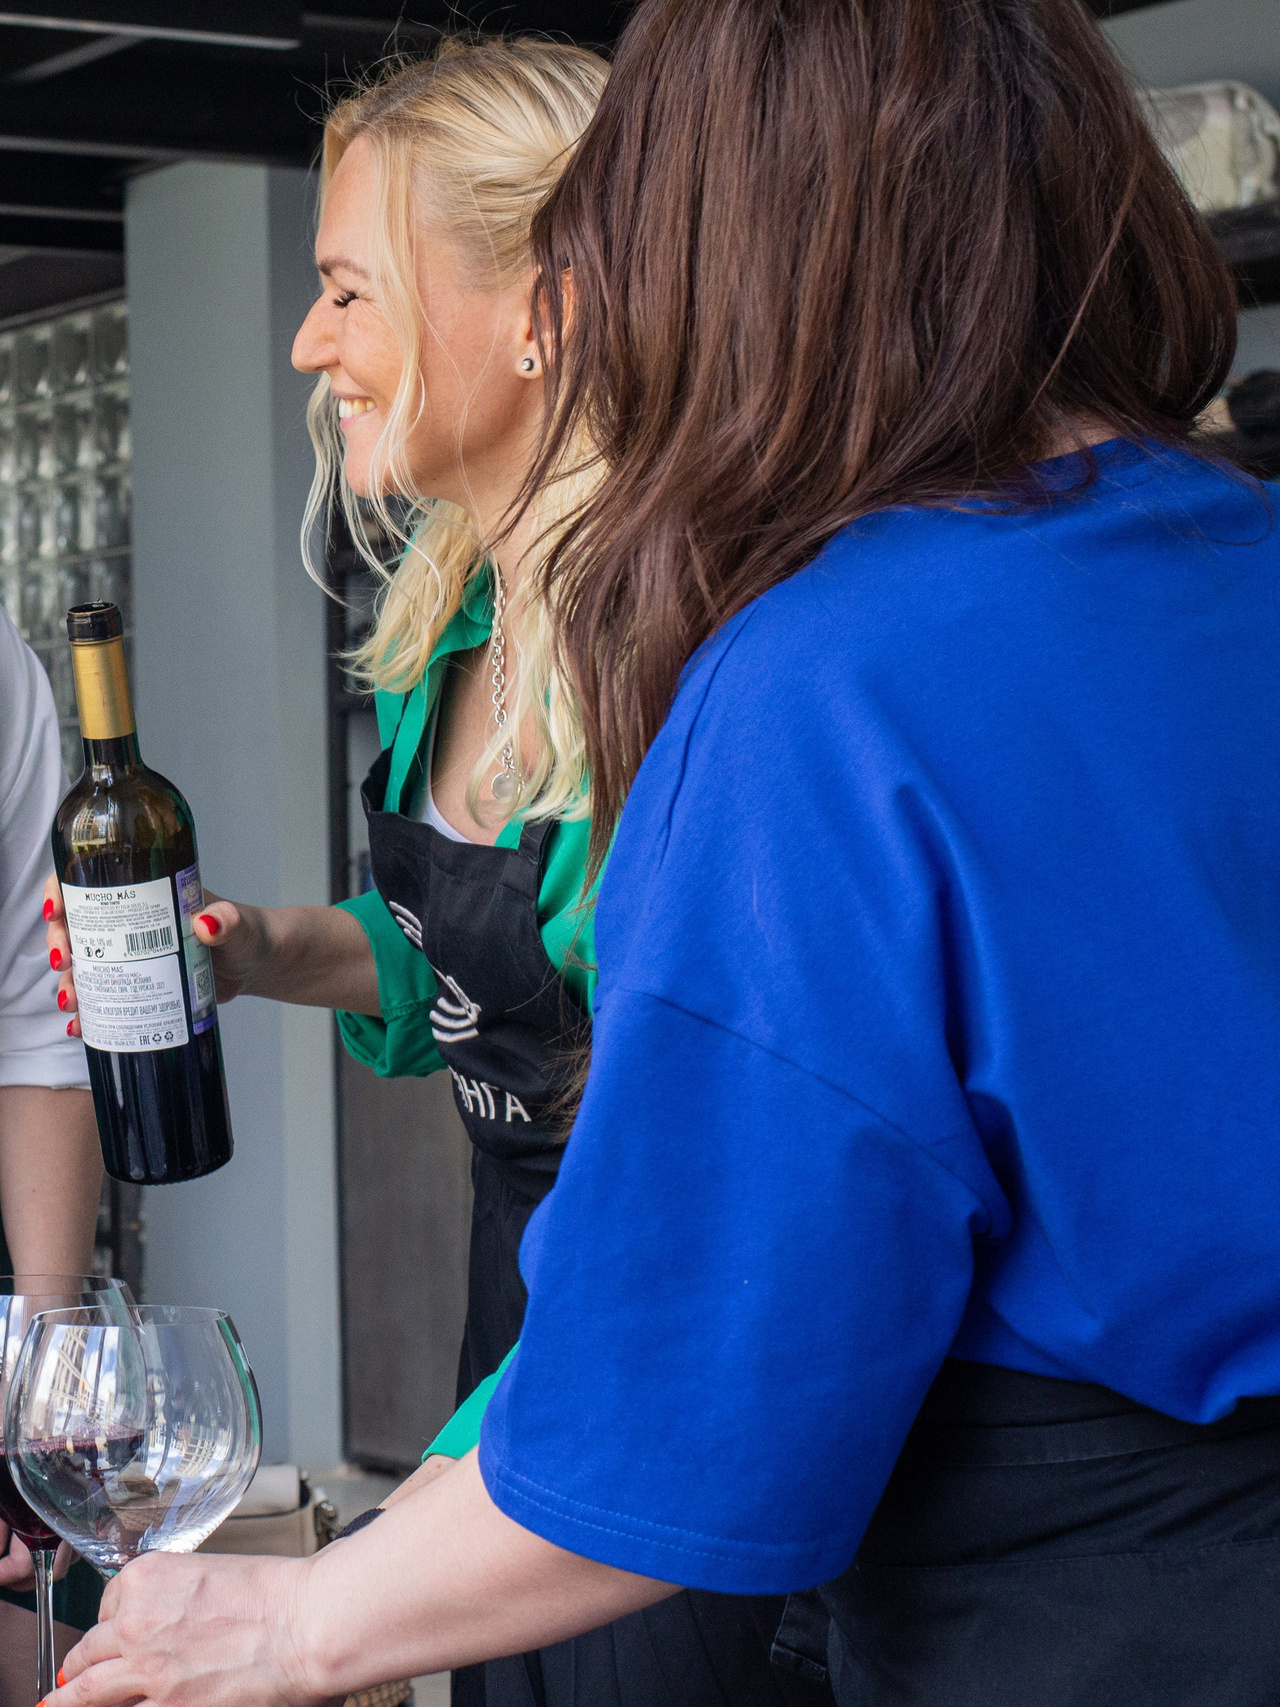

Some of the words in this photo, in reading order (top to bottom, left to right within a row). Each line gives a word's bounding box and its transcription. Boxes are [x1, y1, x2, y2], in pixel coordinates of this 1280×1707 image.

[85, 892, 113, 901] MUCHO
[117, 889, 136, 900] MÁS
[123, 1004, 140, 1017] ВРЕДИТ
[139, 1003, 158, 1015] ВАШЕМУ
